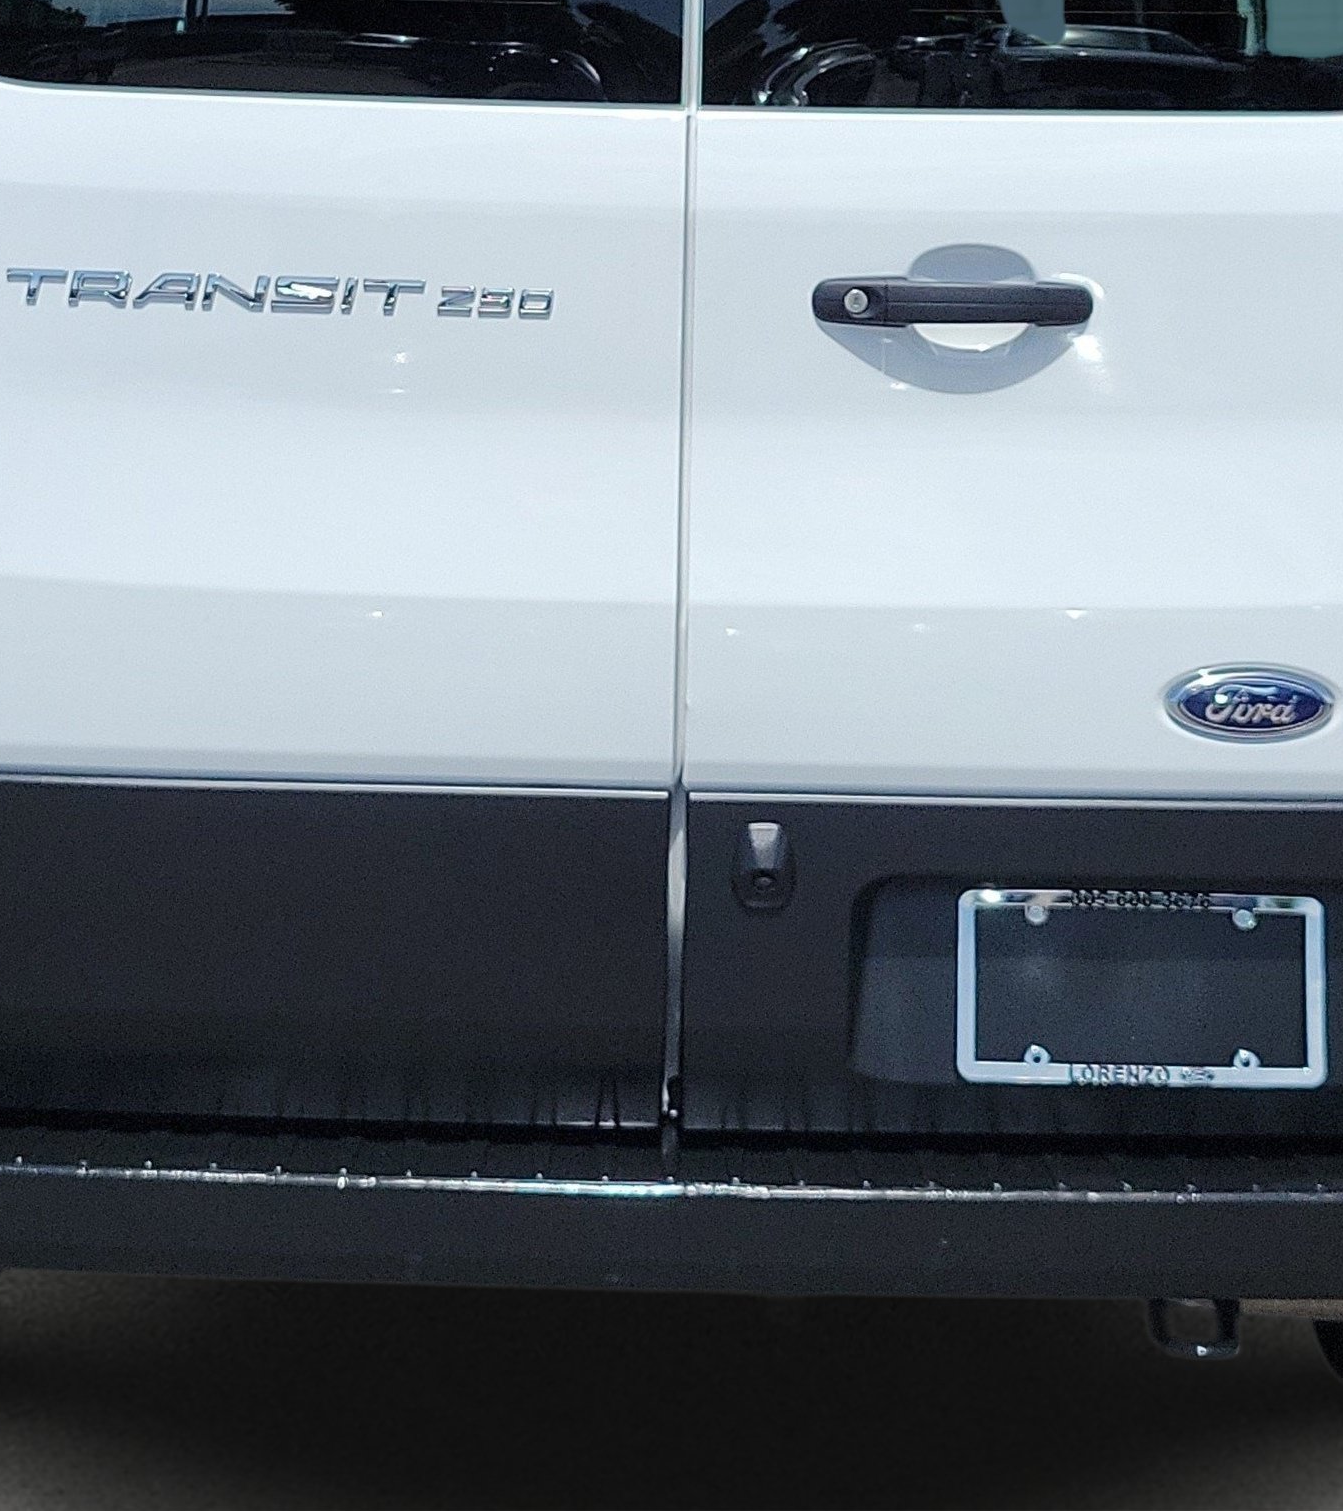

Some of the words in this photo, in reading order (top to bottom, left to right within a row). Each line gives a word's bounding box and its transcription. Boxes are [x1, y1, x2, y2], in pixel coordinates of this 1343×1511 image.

[6, 266, 426, 316] TRANSIT
[437, 284, 555, 320] 250
[1205, 684, 1299, 724] Ford
[1069, 1063, 1171, 1087] LORENZO
